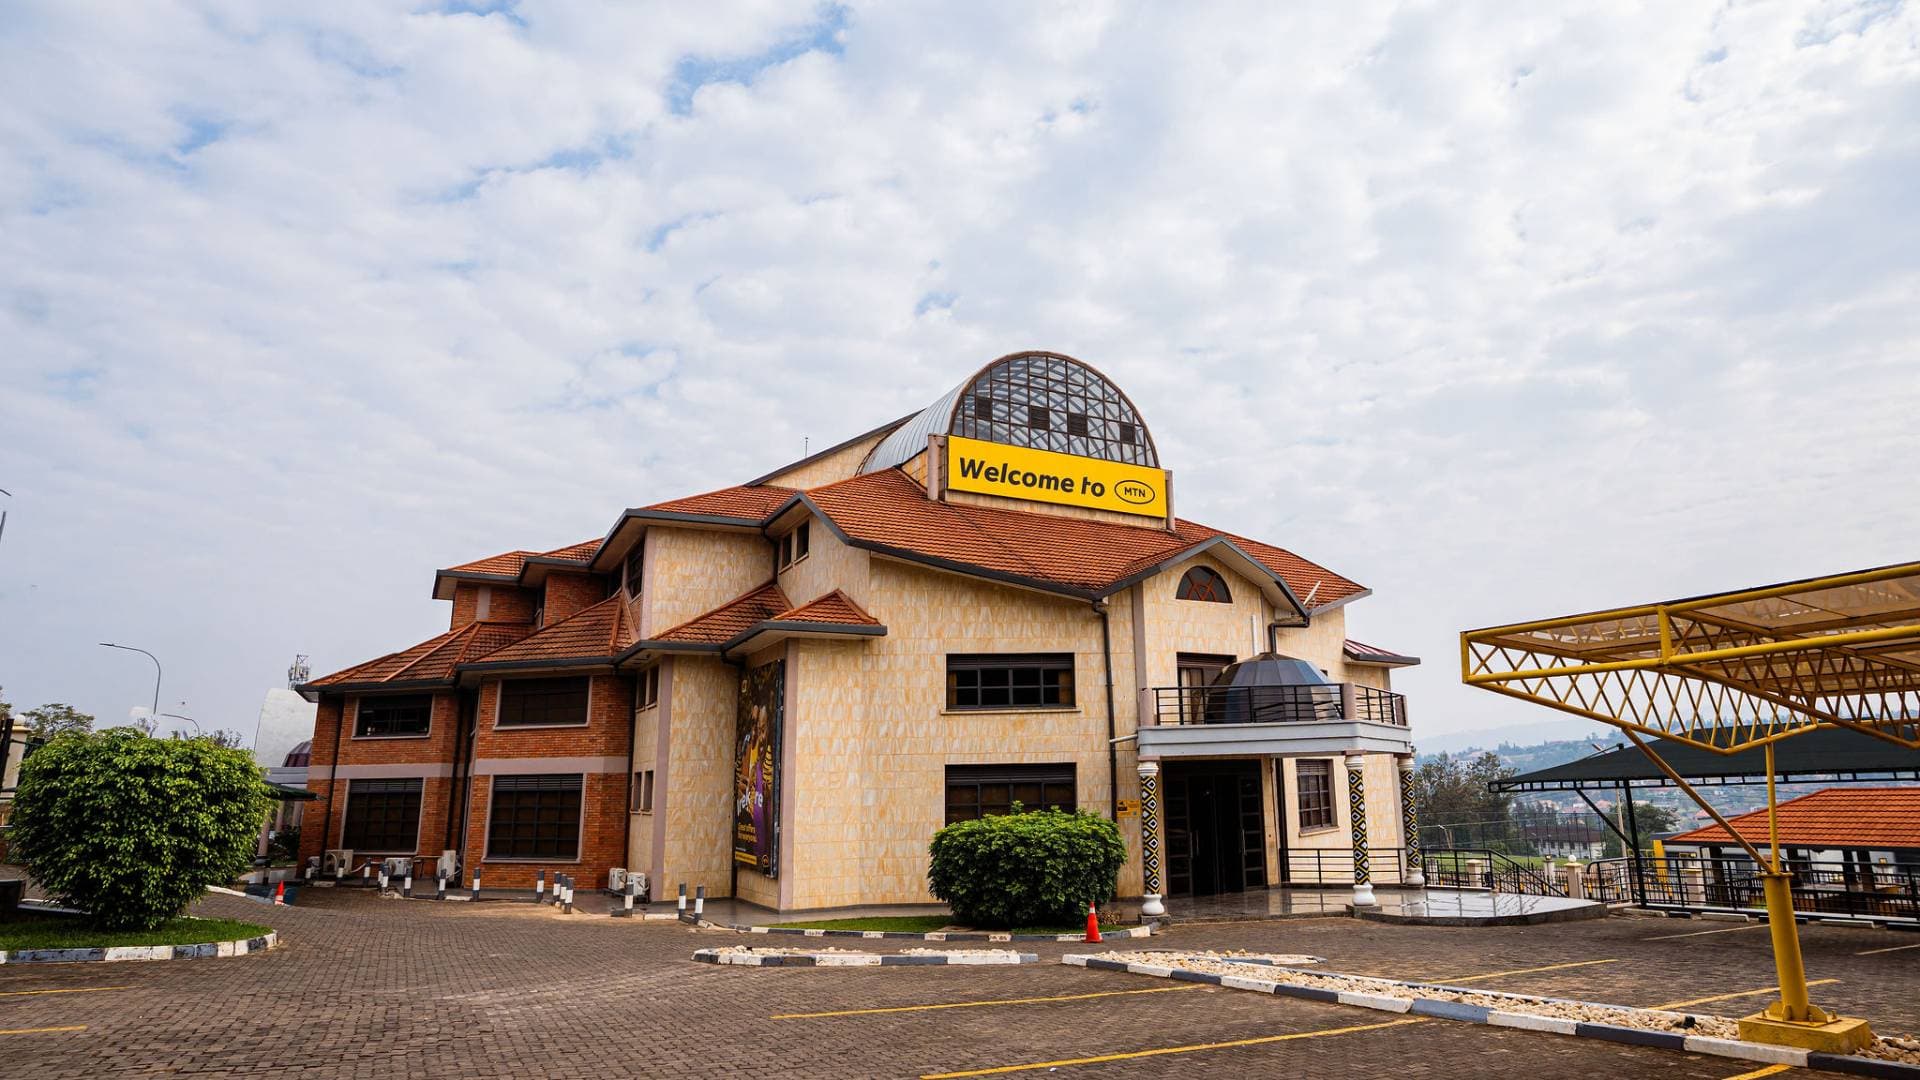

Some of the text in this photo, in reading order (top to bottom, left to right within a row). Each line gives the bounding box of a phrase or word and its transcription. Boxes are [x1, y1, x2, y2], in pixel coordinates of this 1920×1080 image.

[959, 457, 1146, 498] Welcome to MTN
